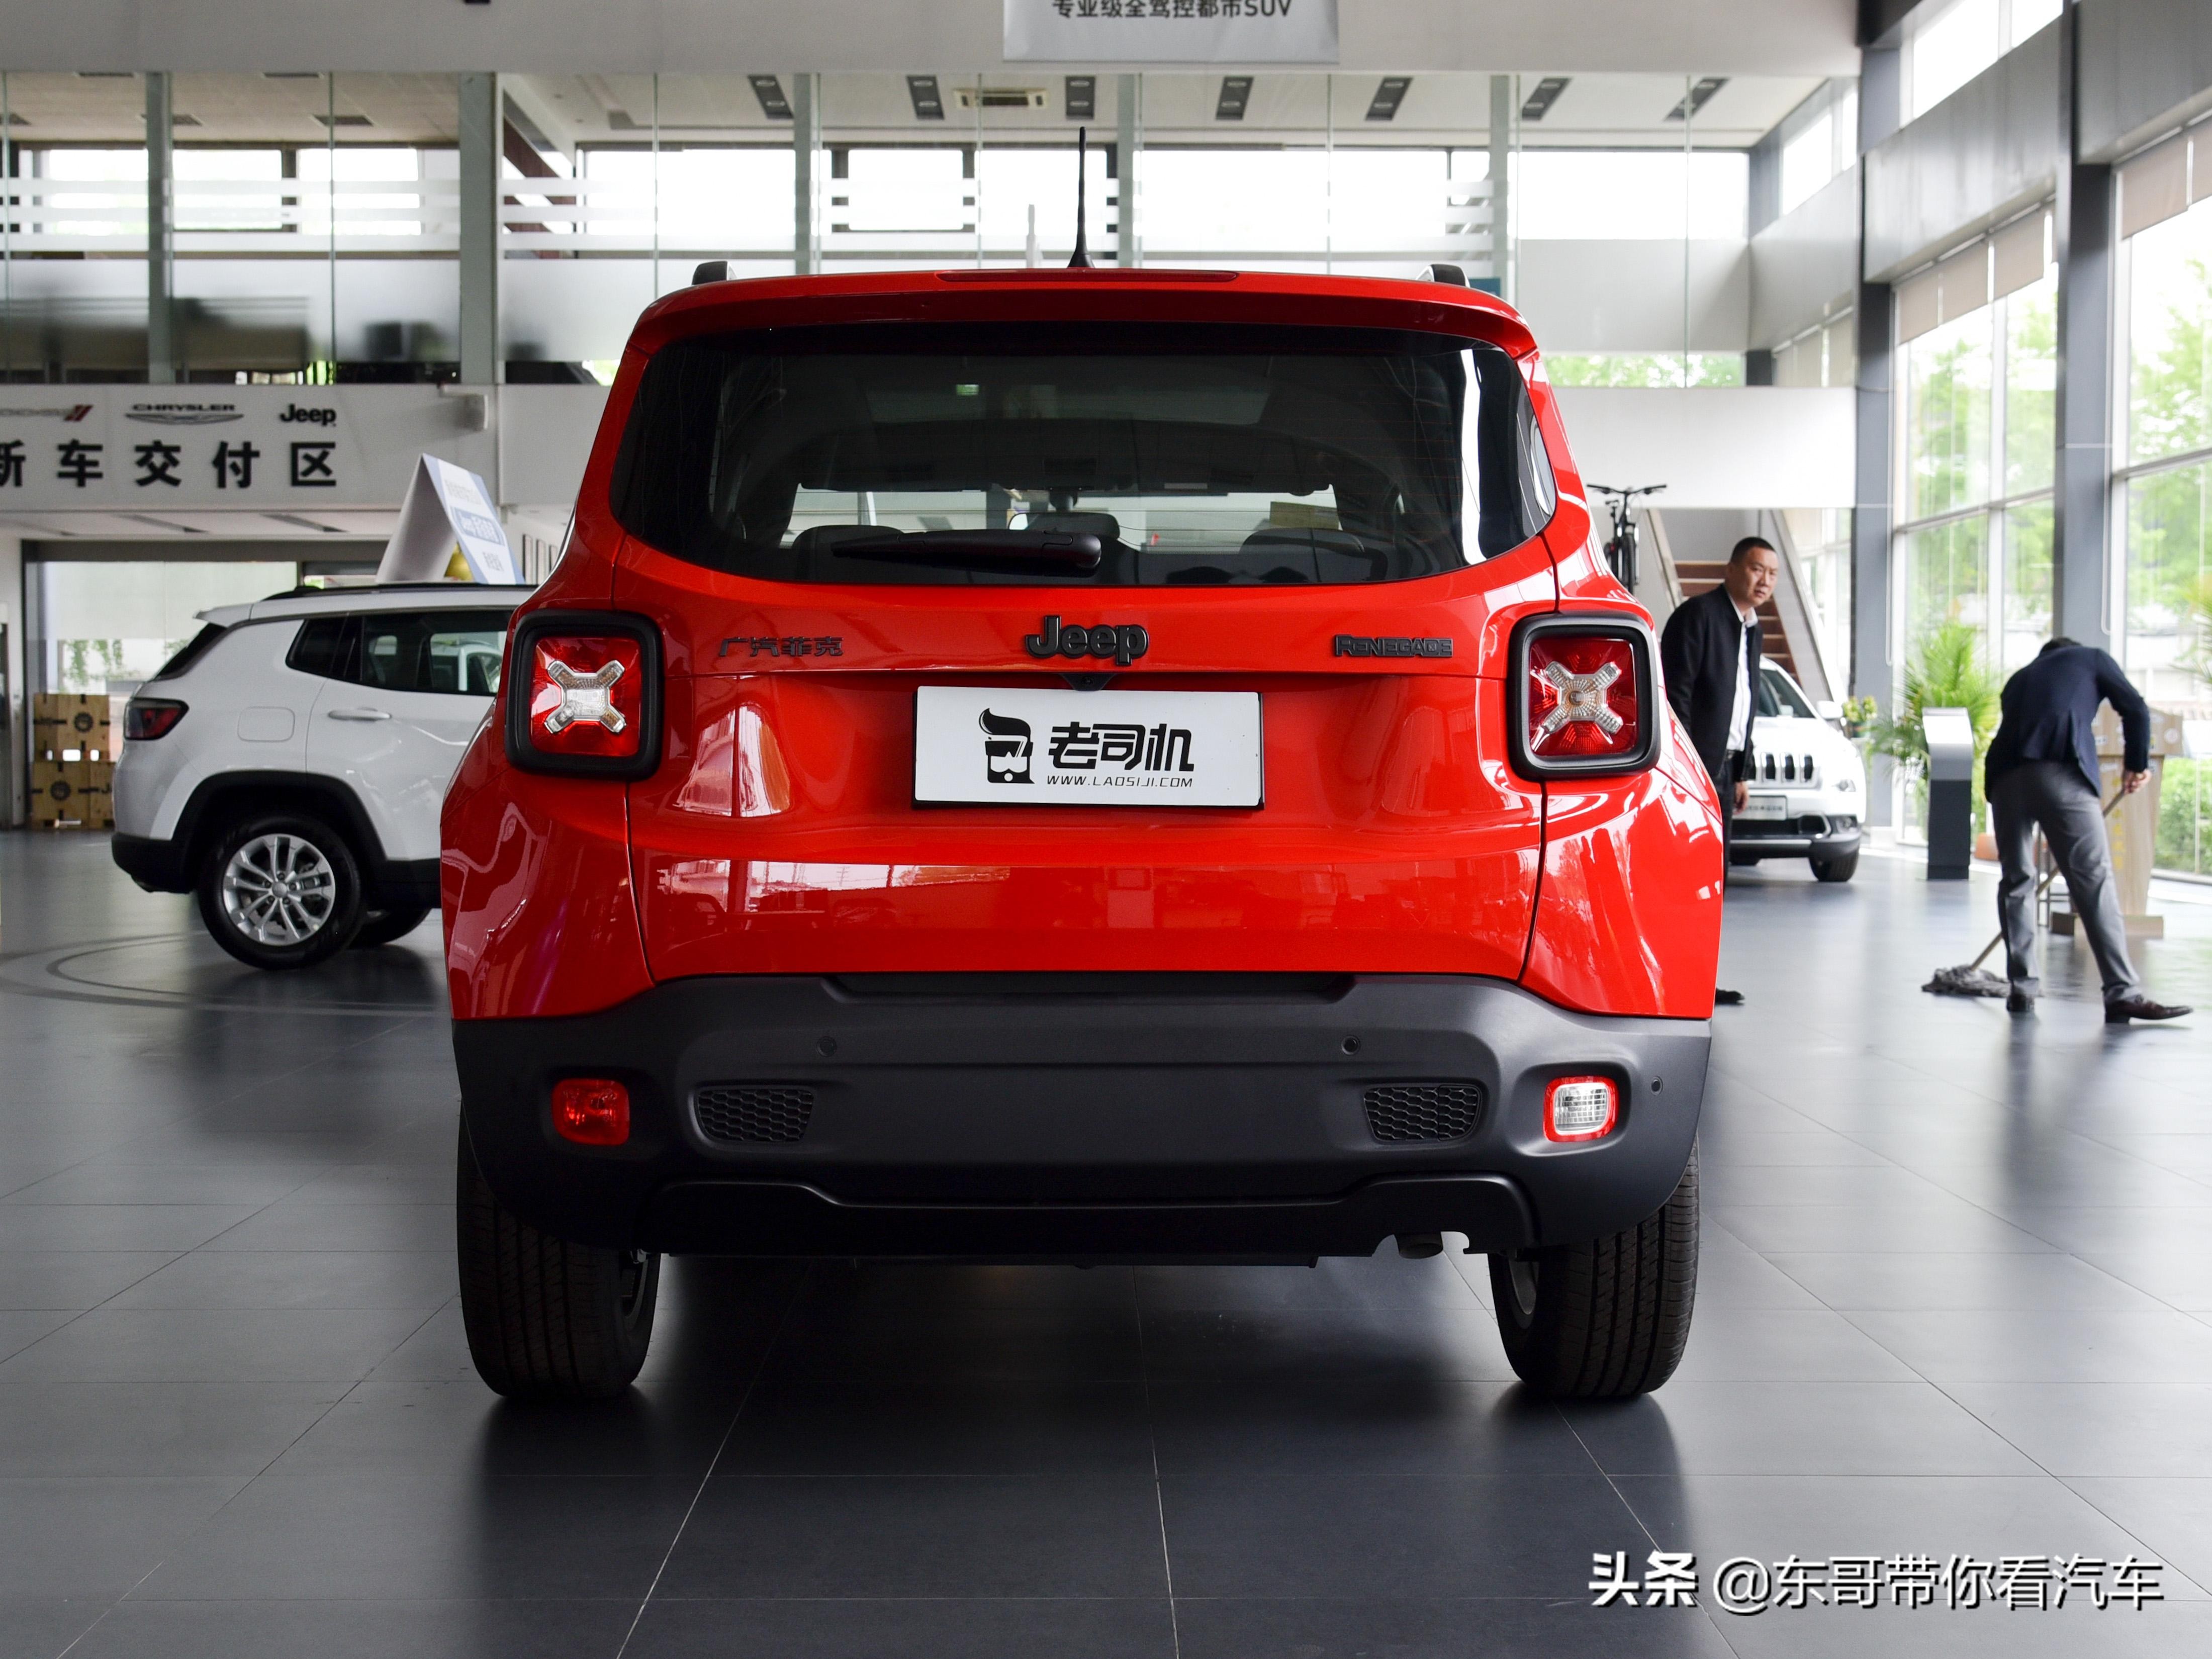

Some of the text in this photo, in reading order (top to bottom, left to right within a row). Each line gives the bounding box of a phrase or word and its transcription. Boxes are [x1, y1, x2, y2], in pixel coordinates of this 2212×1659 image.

[280, 404, 337, 426] Jeep
[718, 636, 845, 657] 广汽菲克
[1025, 615, 1149, 666] Jeep
[1335, 634, 1453, 658] RENEGADE
[1048, 721, 1194, 772] 老司机
[1047, 775, 1193, 788] WWW.LAOSIJI.COM
